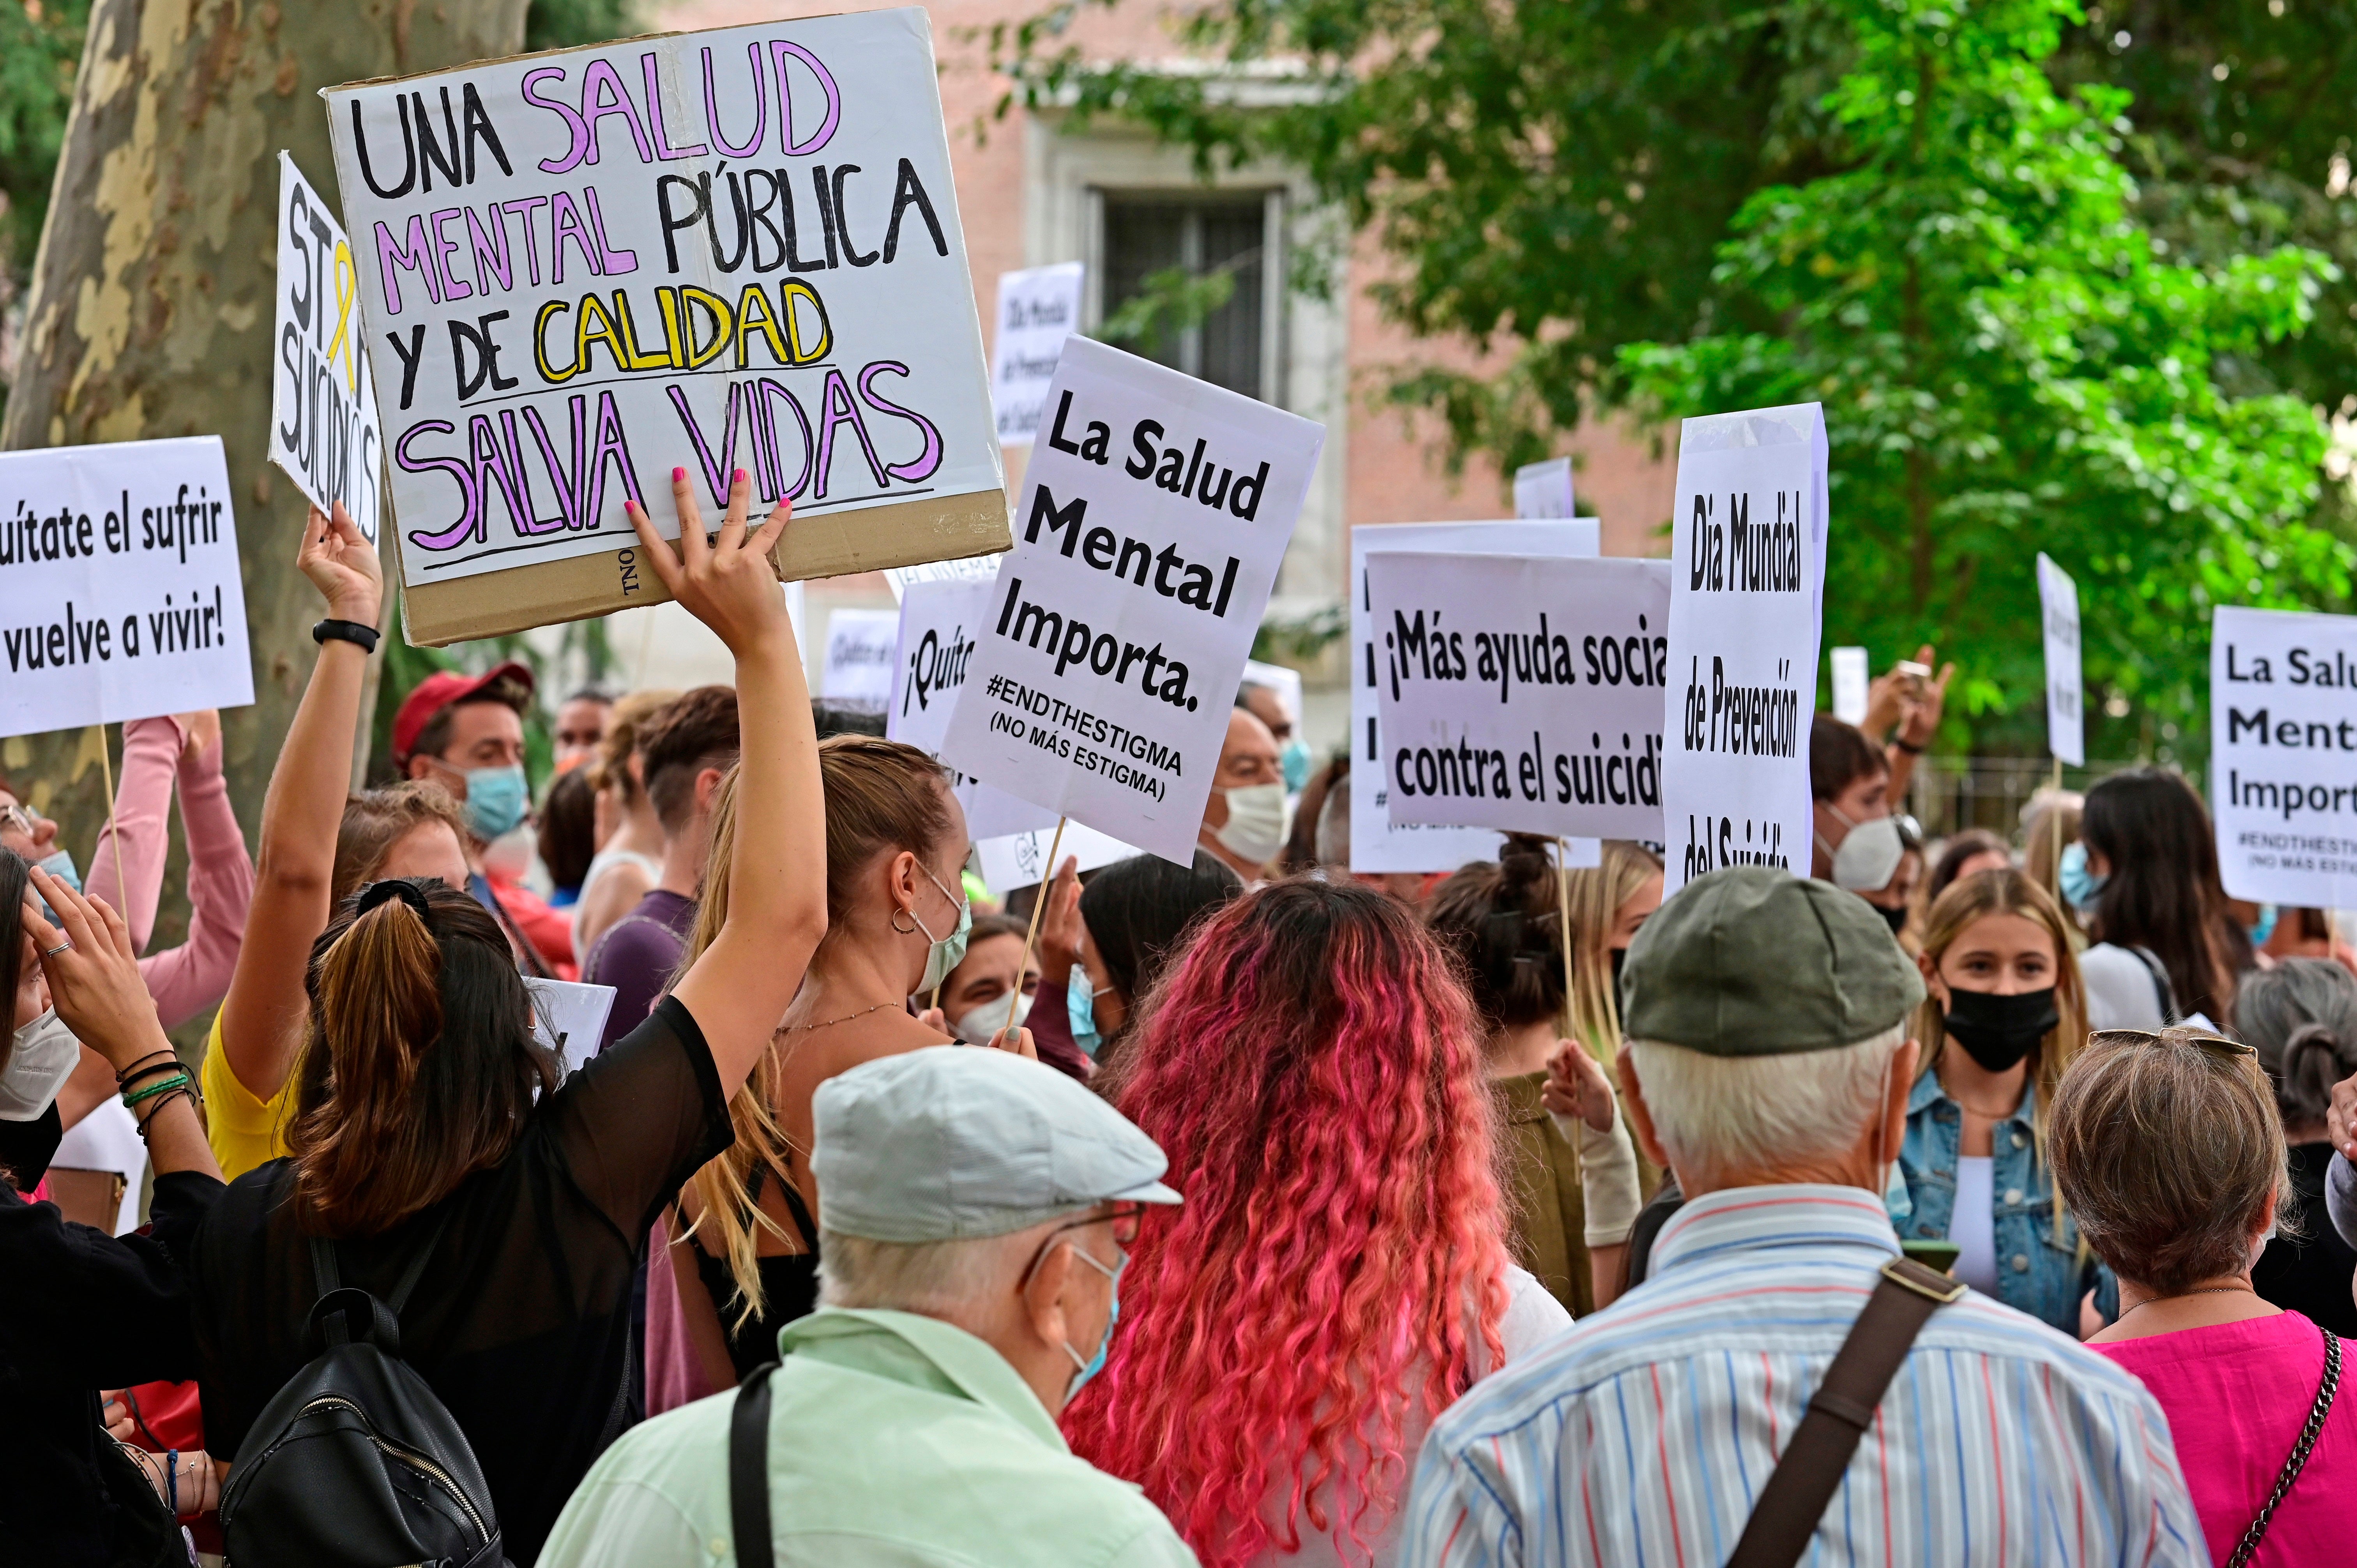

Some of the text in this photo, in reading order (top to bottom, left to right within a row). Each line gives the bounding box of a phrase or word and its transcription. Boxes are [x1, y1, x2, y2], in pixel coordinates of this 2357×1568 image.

[351, 40, 840, 199] UNA SALUD
[373, 158, 949, 315] MENTAL PÚBLICA
[386, 277, 834, 410] Y DE CALIDAD
[395, 360, 944, 551] SALVA VIDAS
[1048, 389, 1270, 522] La Salud
[104, 490, 130, 554] el
[142, 484, 222, 564] sufrir
[1024, 484, 1240, 618] Mental
[1729, 490, 1800, 593] Mundial
[4, 585, 224, 673] vuelve a vivir!
[996, 577, 1198, 712] Importa.
[1386, 609, 1467, 702] ¡Más
[1475, 612, 1576, 704] ayuda
[2226, 644, 2273, 684] La
[986, 674, 1181, 777] #ENDTHESTIGMA
[990, 711, 1165, 803] (NO MÁS ESTIGMA)
[1684, 655, 1797, 758] de Prevención
[2228, 706, 2356, 752] Ment
[1395, 735, 1512, 800] contra
[1518, 731, 1546, 803] el
